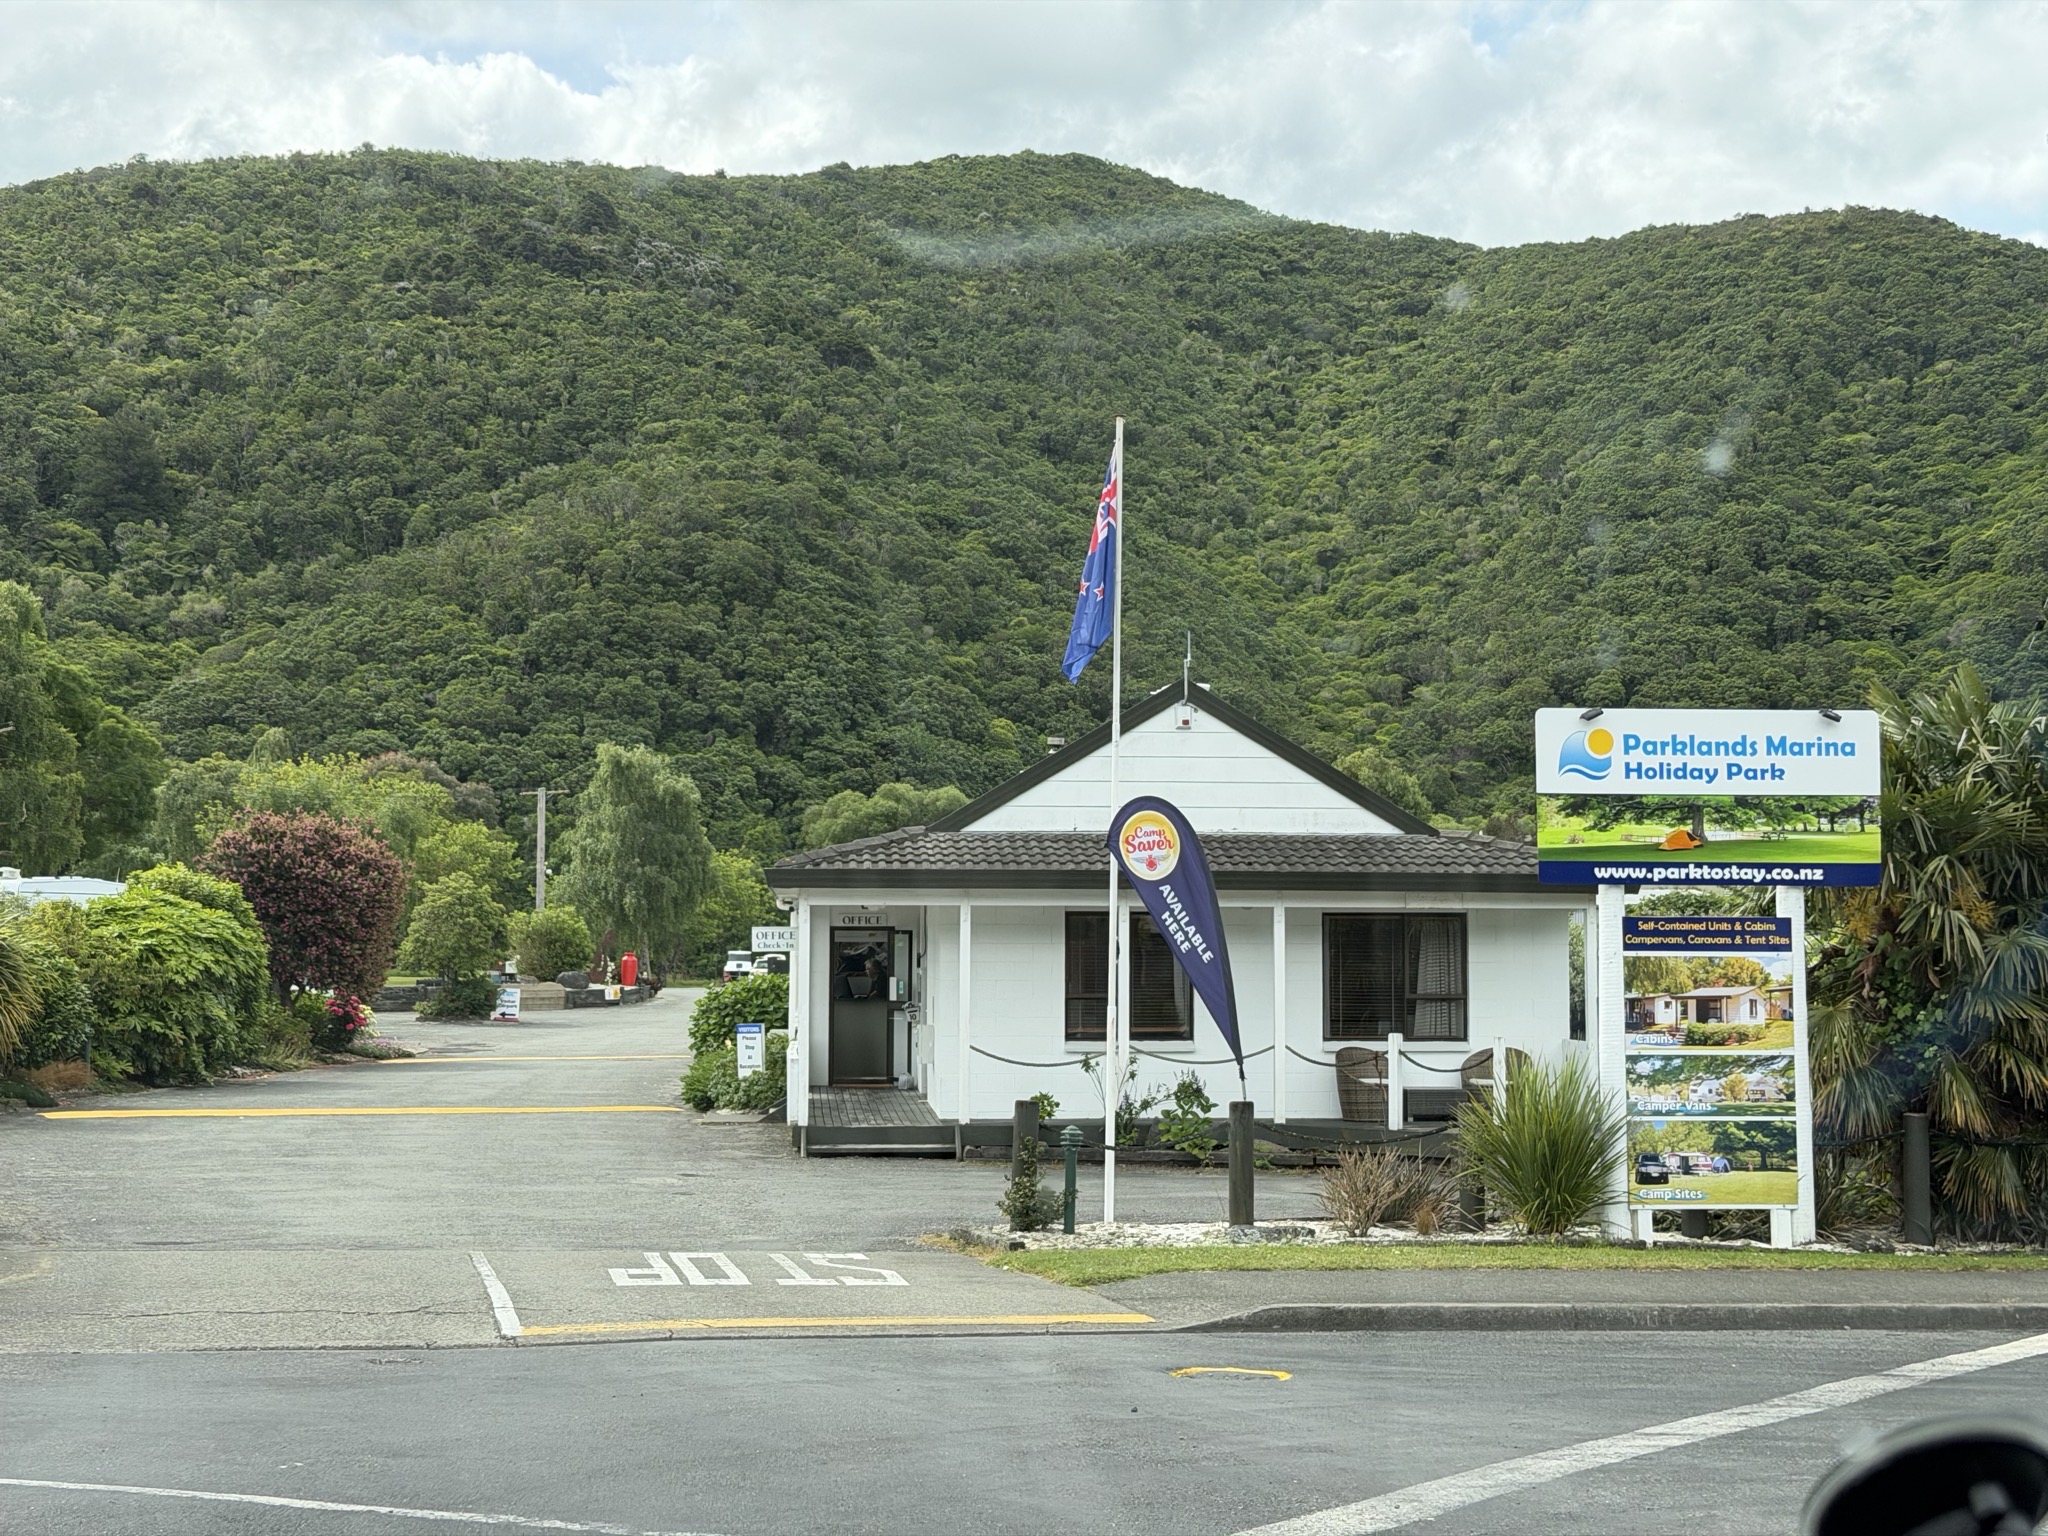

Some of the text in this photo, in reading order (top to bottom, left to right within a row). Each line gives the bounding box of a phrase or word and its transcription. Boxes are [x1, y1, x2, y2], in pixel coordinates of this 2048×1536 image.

[1623, 734, 1856, 757] Parklands Marina
[1624, 761, 1786, 784] Holiday Park
[1134, 826, 1166, 838] Camp
[1125, 834, 1174, 854] Saver
[1594, 863, 1824, 882] www.parktostay.co.nz
[842, 915, 883, 925] OFFICE
[1159, 884, 1214, 964] AVAILABLE
[1638, 921, 1776, 931] Self-Contained Units & Cabins
[755, 931, 796, 940] OFFICE
[1161, 911, 1191, 953] HERE
[1625, 934, 1790, 945] Campervans, Caravans & Tent Sites
[1636, 1033, 1674, 1044] Cabins
[1637, 1101, 1712, 1113] Camper Vans
[1640, 1189, 1702, 1200] Camp Sites
[607, 1251, 911, 1286] STOP
